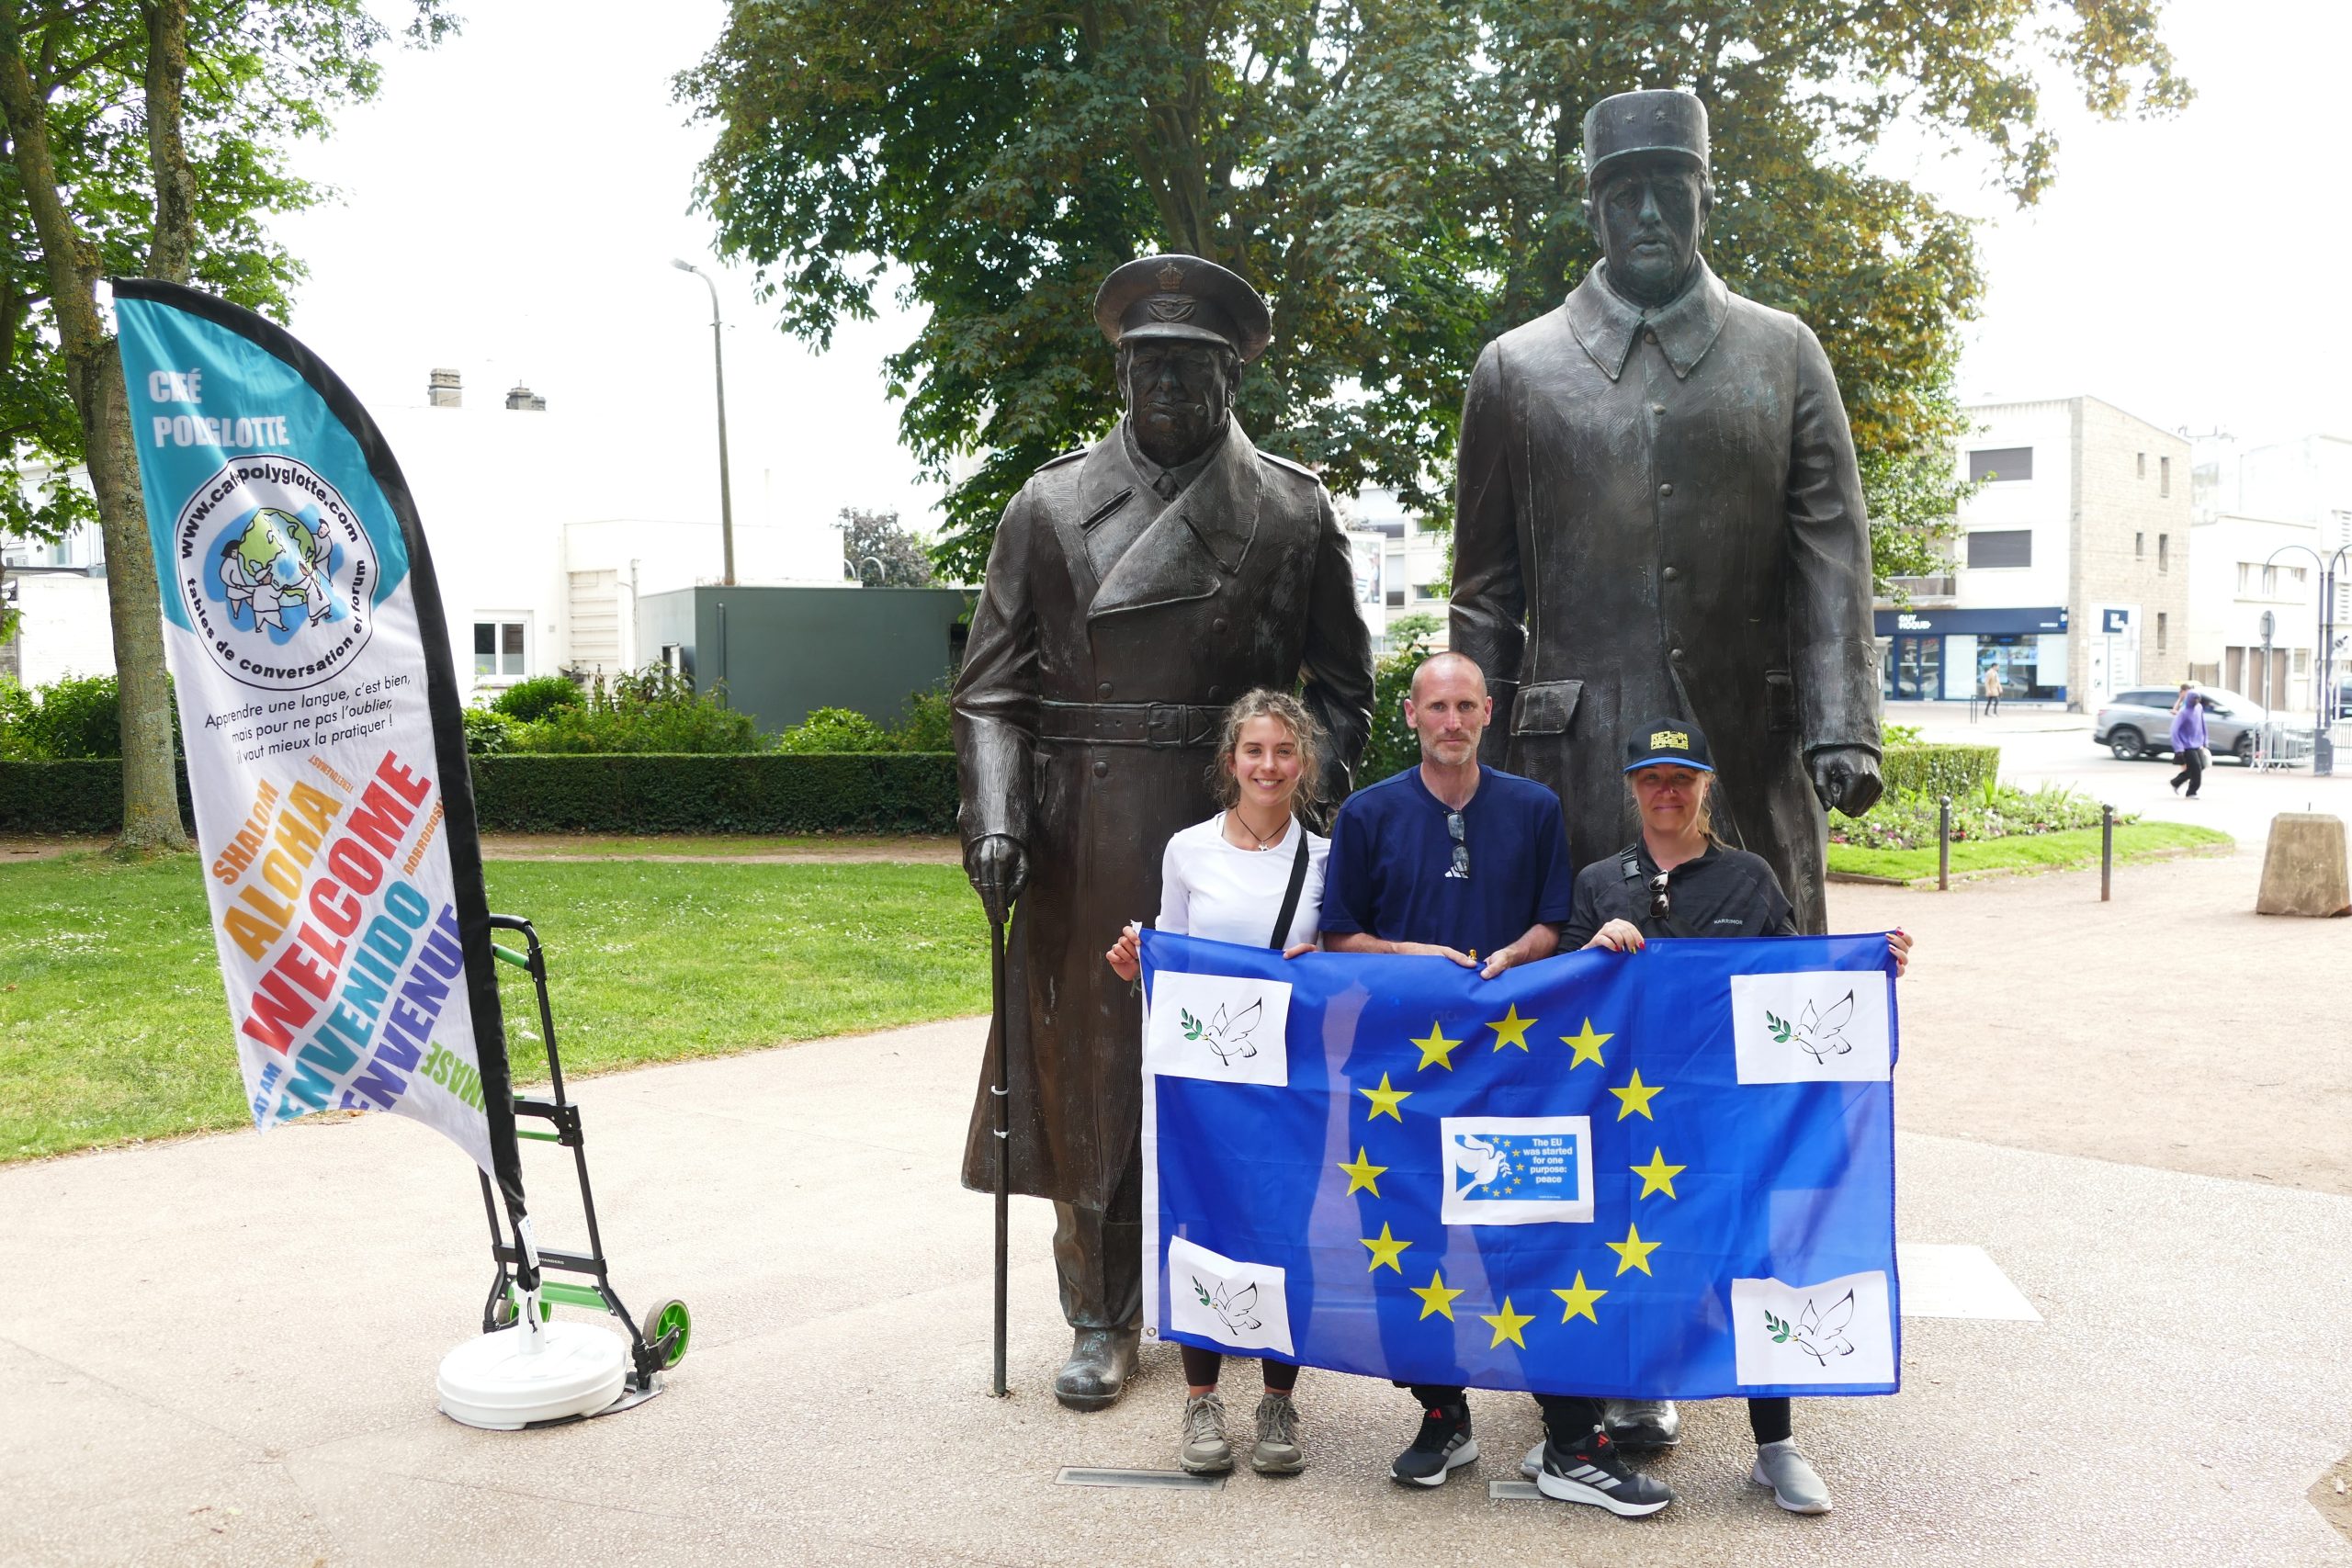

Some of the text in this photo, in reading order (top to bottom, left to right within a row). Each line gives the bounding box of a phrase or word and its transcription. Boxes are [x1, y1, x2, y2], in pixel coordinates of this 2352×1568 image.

[187, 578, 214, 638] tables
[216, 640, 235, 660] de
[240, 637, 354, 679] conversation
[352, 559, 366, 613] forum
[205, 703, 263, 729] Apprendre
[268, 700, 296, 714] une
[301, 691, 349, 708] langue,
[384, 675, 411, 689] bien,
[232, 727, 253, 742] mais
[256, 721, 288, 740] pour
[293, 717, 311, 730] ne
[315, 712, 337, 729] pas
[236, 750, 242, 764] il
[243, 745, 265, 761] vaut
[268, 738, 311, 755] mieux
[315, 731, 326, 745] la
[332, 719, 385, 745] pratiquer
[212, 777, 279, 886] SHALOM
[222, 780, 343, 963] ALOHA
[241, 750, 432, 1056] WELCOME
[1532, 1138, 1562, 1146] The EU
[1542, 1147, 1573, 1156] started
[1530, 1166, 1567, 1174] purpose:
